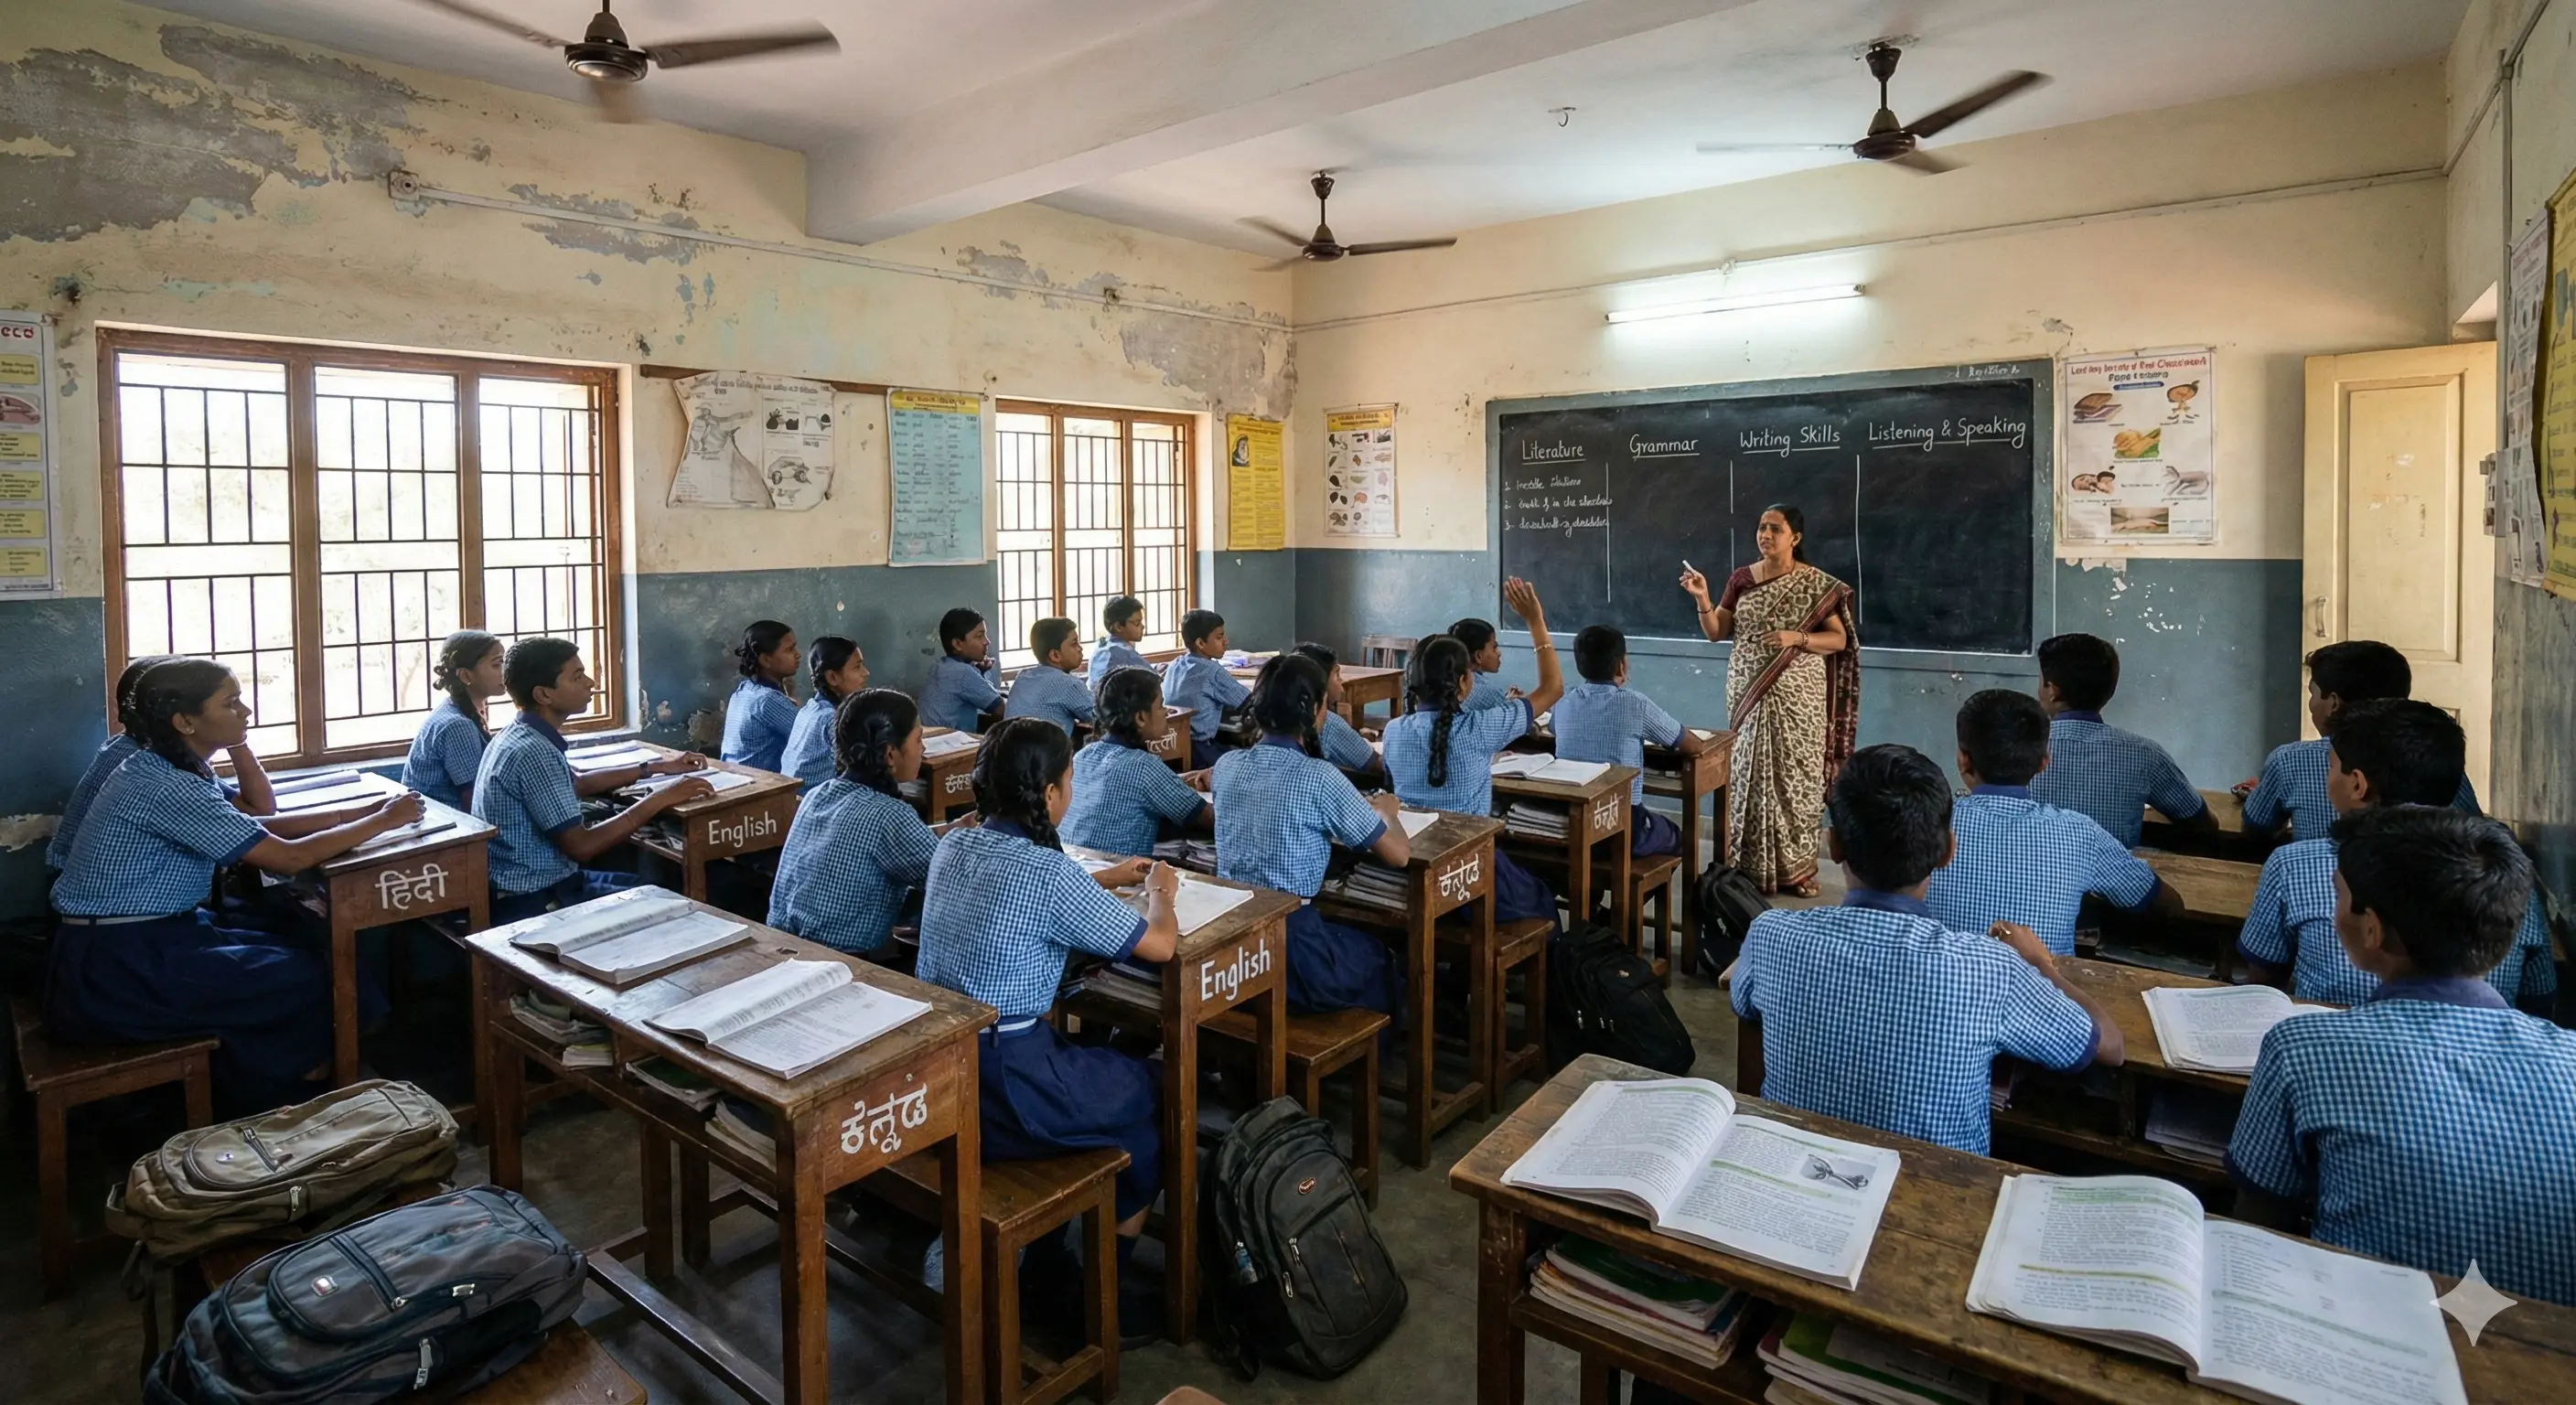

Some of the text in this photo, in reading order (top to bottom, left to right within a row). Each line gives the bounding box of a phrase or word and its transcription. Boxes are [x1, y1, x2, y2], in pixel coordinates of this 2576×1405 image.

[1522, 439, 1584, 460] Literature
[1629, 434, 1700, 462] Grammar
[1740, 424, 1841, 457] Writing Skills
[1869, 415, 2026, 452] Listening & Speaking
[708, 810, 777, 848] English
[374, 863, 448, 910] हिंदी
[1201, 938, 1271, 1002] English
[841, 1082, 928, 1154] ಕನ್ನಡ
